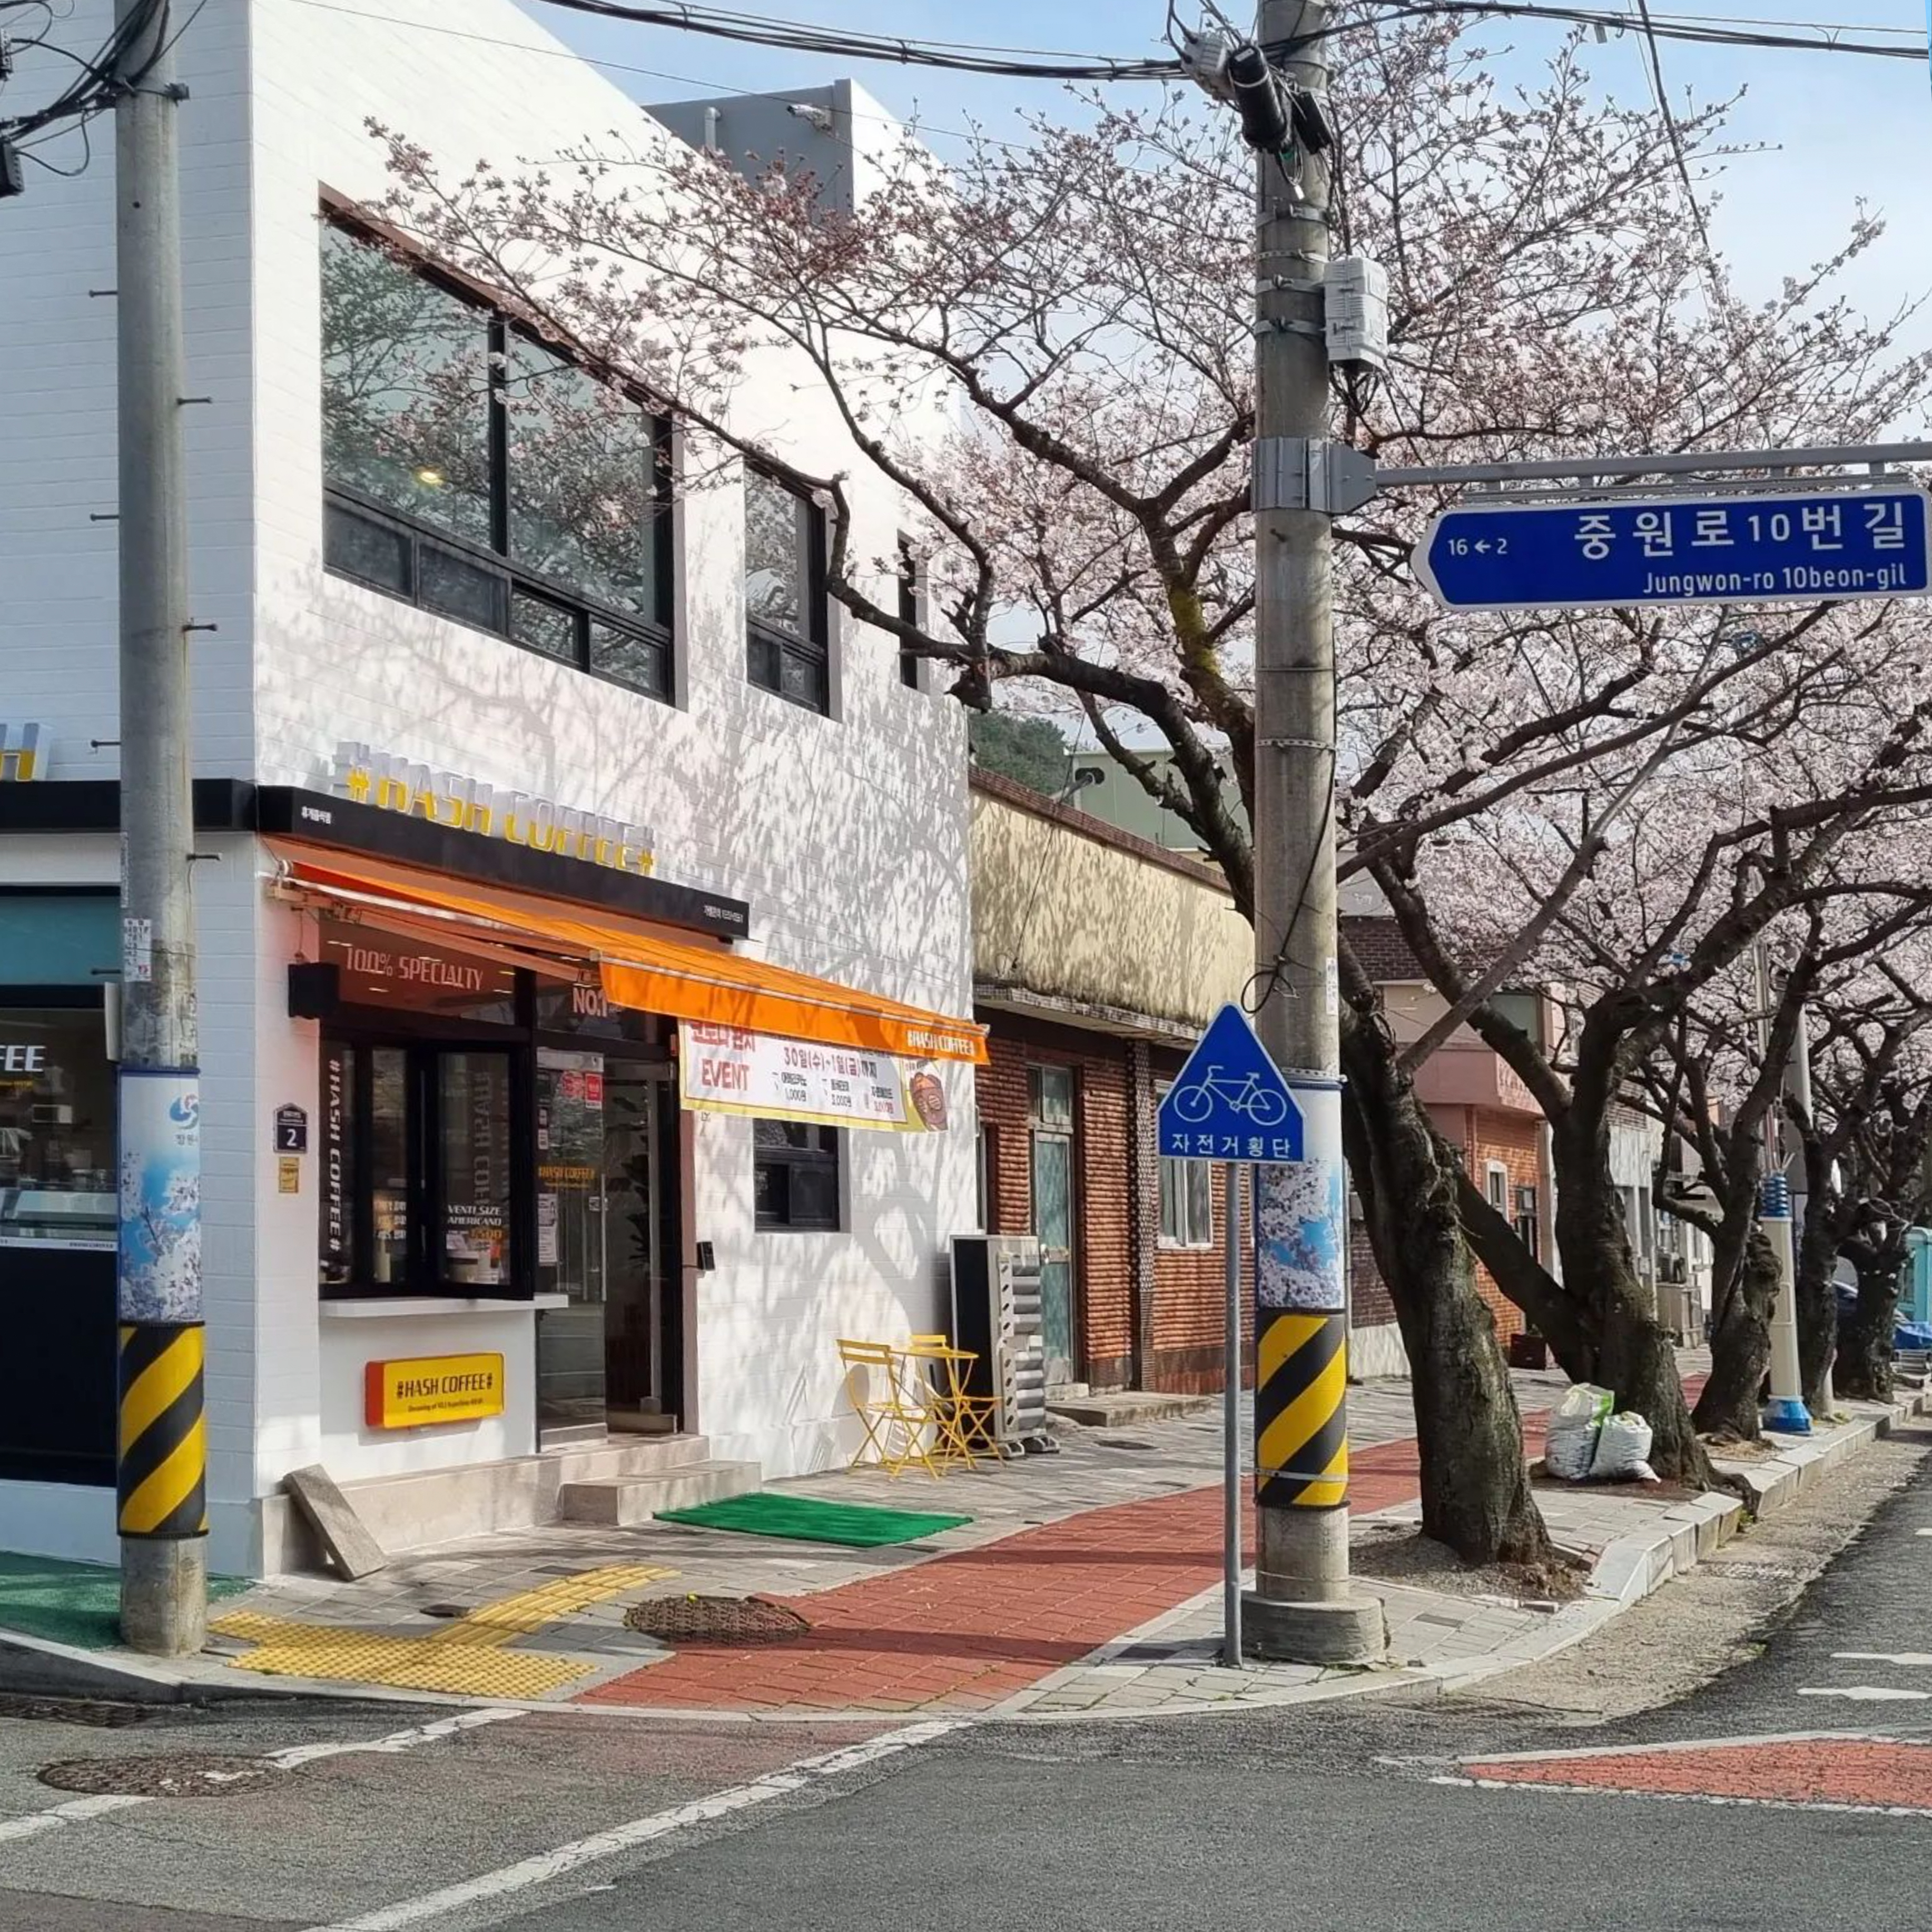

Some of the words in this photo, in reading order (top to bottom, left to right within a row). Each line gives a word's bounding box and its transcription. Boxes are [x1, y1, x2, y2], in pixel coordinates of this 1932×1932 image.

[1574, 502, 1905, 560] 중원로10번길
[1447, 538, 1467, 557] 16
[1496, 538, 1509, 555] 2
[1643, 571, 1775, 595] Jungwon-ro
[1782, 563, 1906, 590] 10beon-gil
[346, 947, 393, 977] 100%
[399, 956, 484, 991] SPECIALTY
[702, 1058, 751, 1091] EVENT
[287, 1128, 297, 1147] 2
[1172, 1133, 1290, 1159] 자전거횡단
[448, 1205, 477, 1214] VENTI
[478, 1206, 501, 1215] SIZE
[448, 1216, 502, 1226] AMERICANO
[397, 1377, 438, 1399] #HASH
[442, 1372, 493, 1394] COFFEE#
